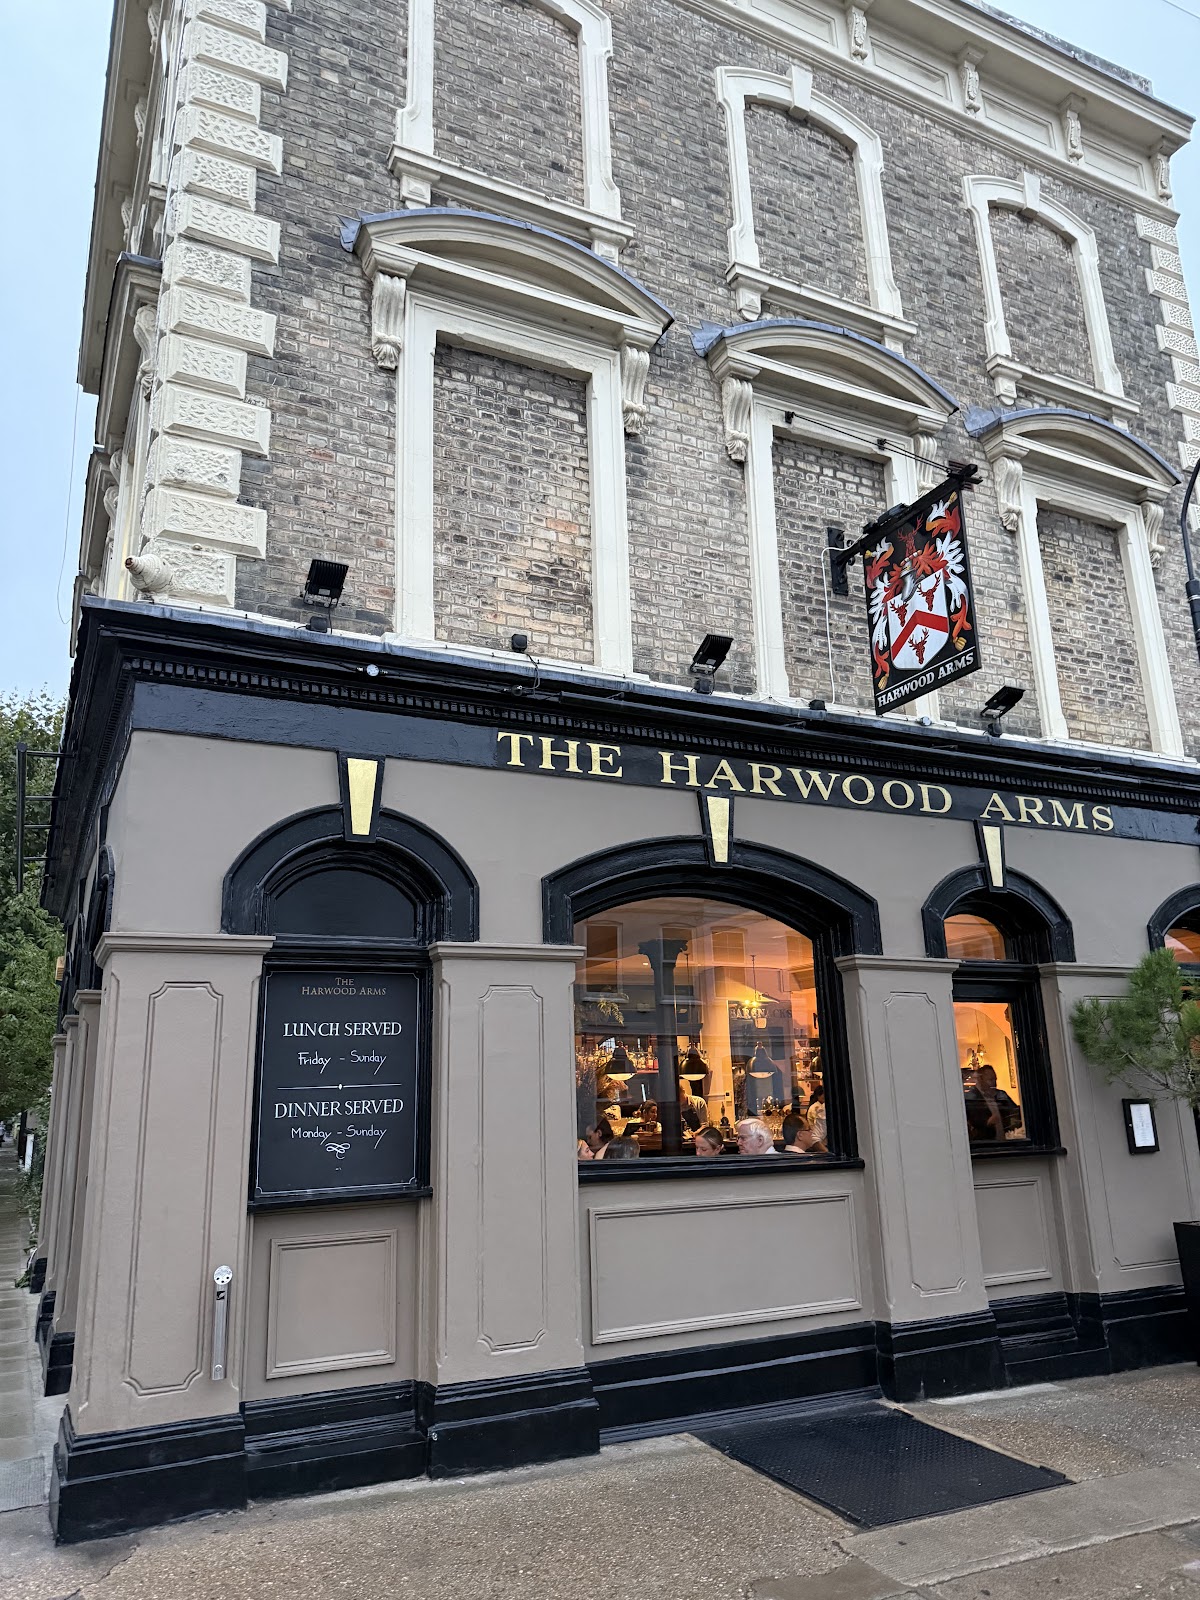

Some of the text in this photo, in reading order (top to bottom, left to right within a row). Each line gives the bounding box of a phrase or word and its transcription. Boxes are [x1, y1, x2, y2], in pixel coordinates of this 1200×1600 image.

[877, 652, 974, 707] HARWOOD ARMS
[497, 731, 1115, 832] THE HARWOOD ARMS
[301, 986, 387, 996] HARWOOD ARMS
[335, 977, 355, 986] THE
[283, 1021, 403, 1037] LUNCH SERVED
[297, 1050, 332, 1075] Friday
[350, 1049, 387, 1076] Sunday
[274, 1098, 404, 1119] DINNER SERVED
[290, 1125, 332, 1146] Monday
[345, 1124, 388, 1150] Sunday
